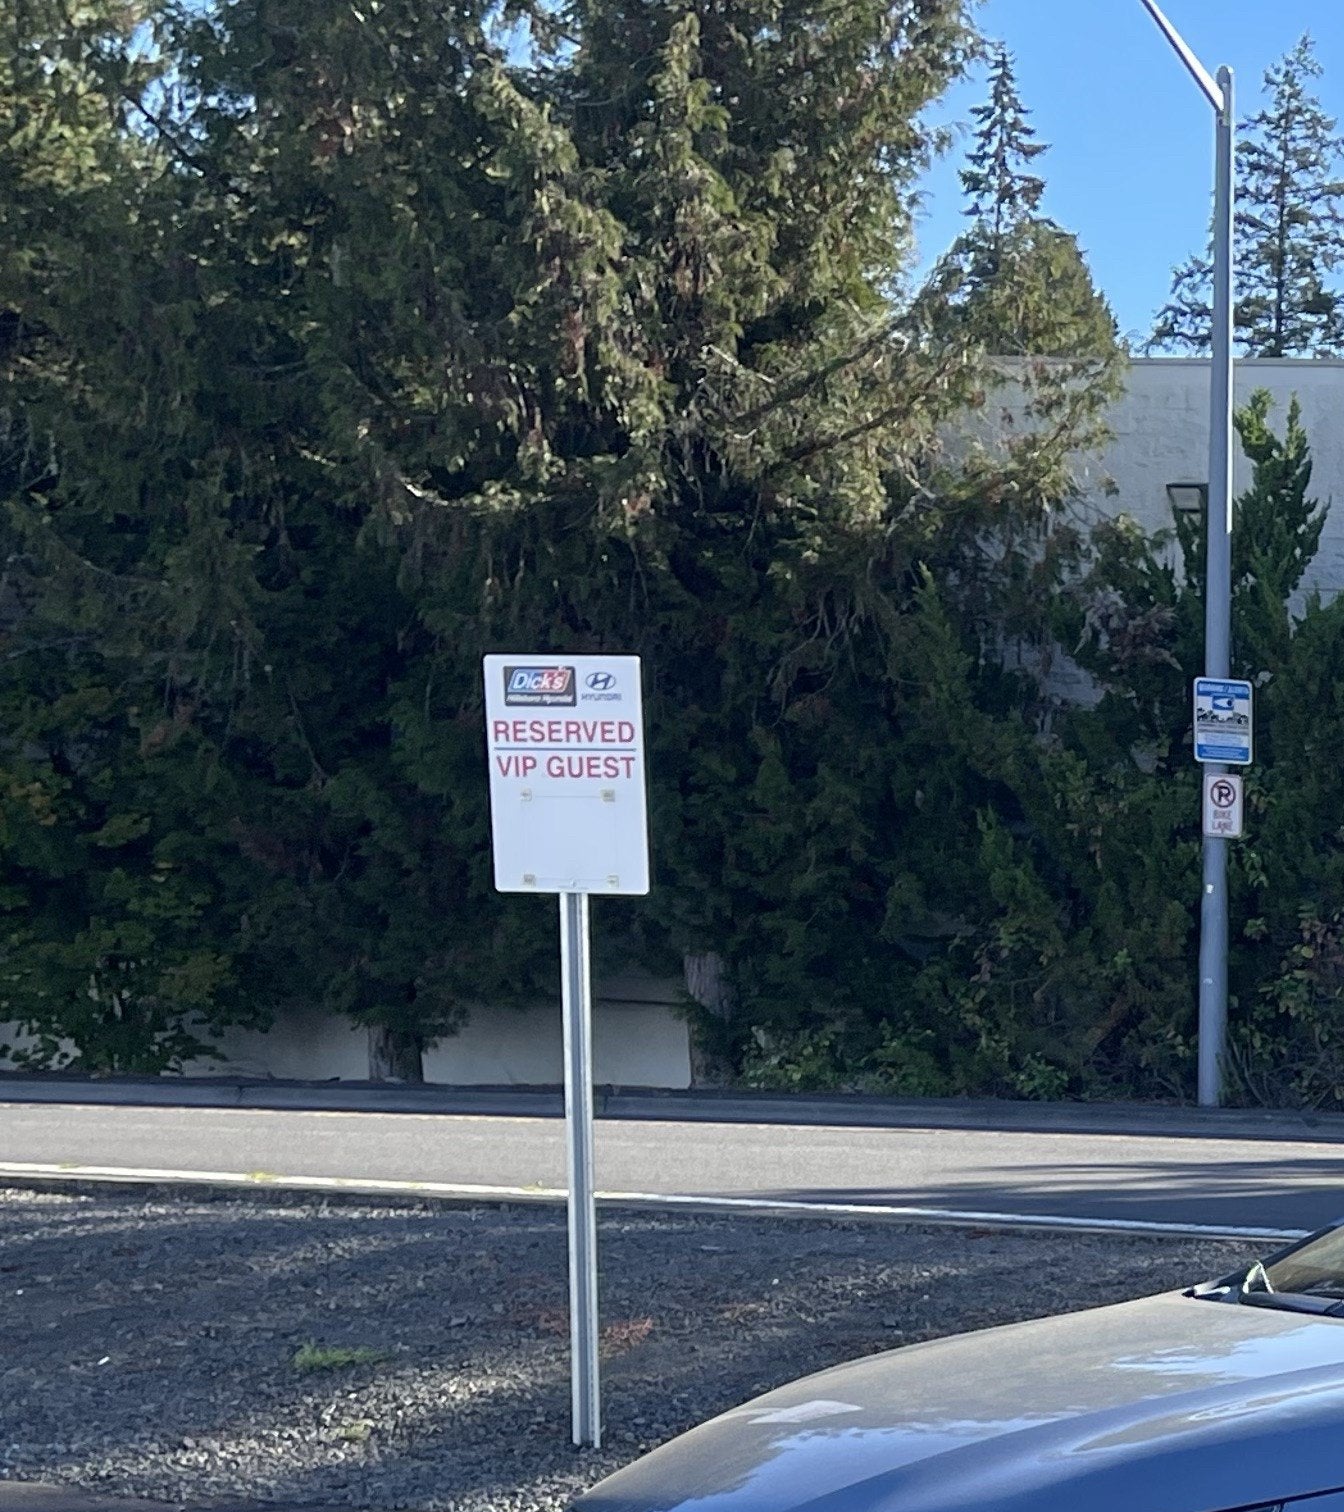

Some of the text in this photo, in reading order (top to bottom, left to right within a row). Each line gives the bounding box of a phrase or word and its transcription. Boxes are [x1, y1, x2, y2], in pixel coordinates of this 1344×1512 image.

[493, 720, 635, 743] RESERVED
[497, 755, 636, 779] VIP GUEST
